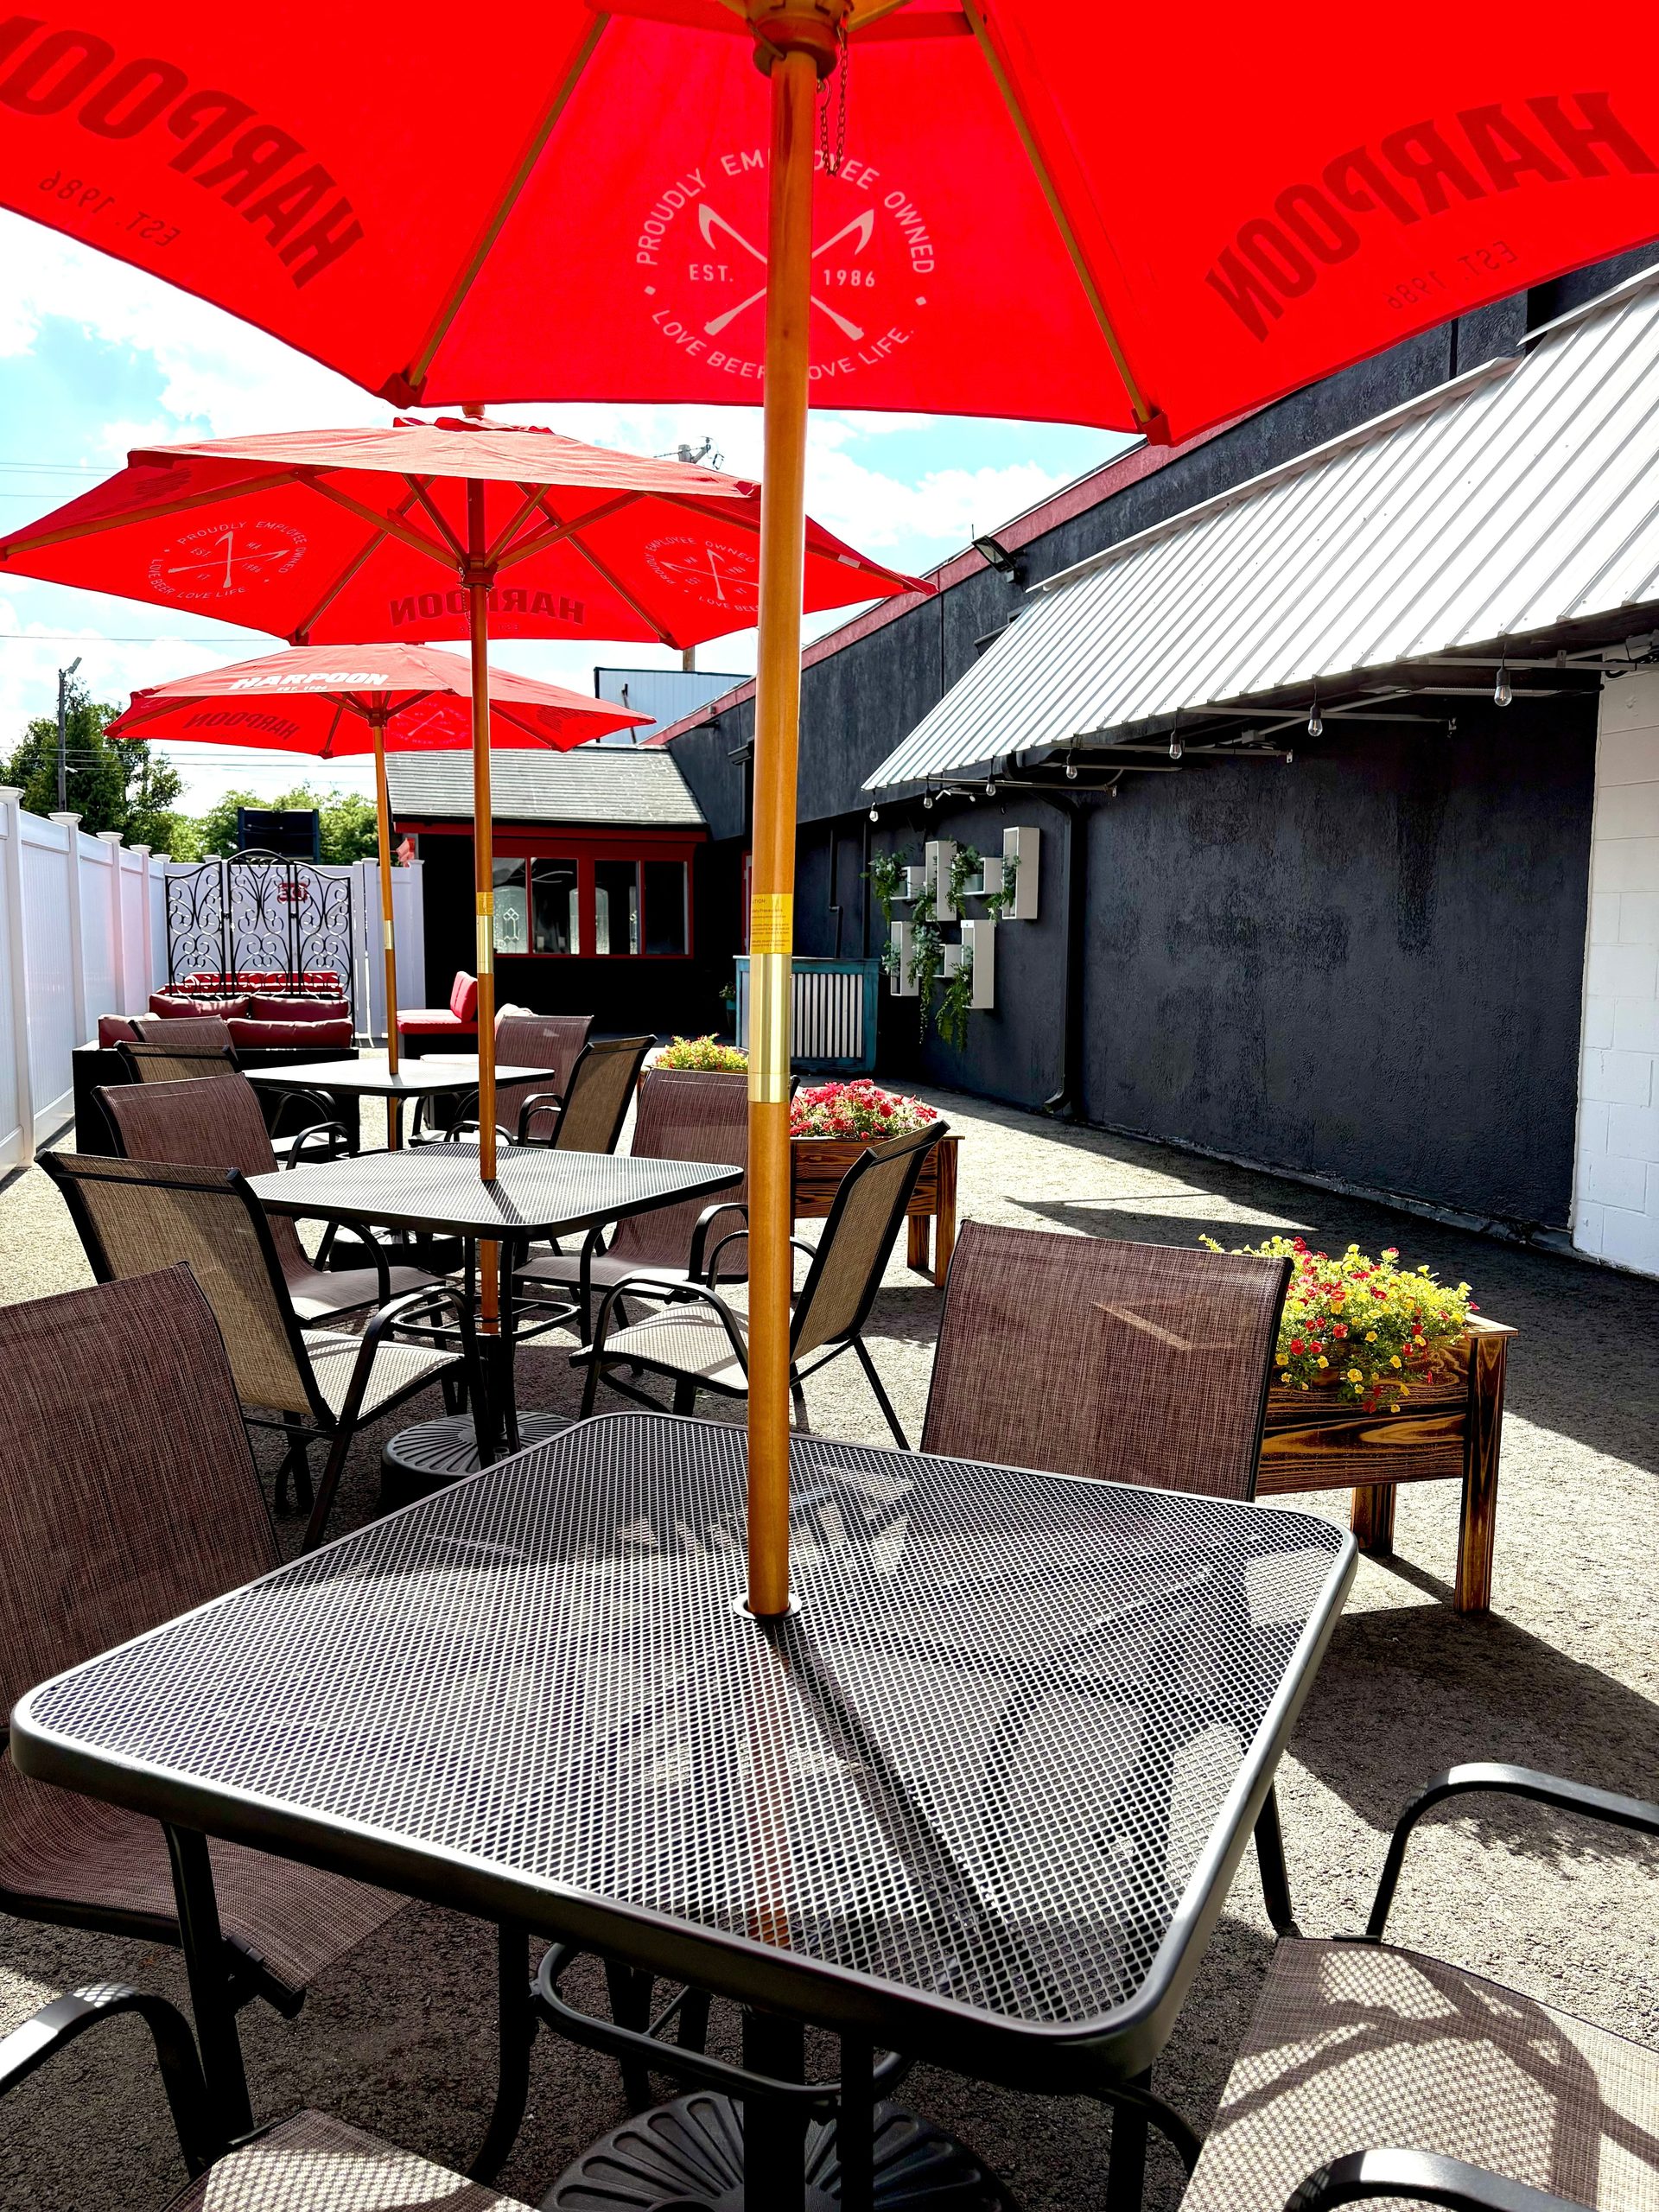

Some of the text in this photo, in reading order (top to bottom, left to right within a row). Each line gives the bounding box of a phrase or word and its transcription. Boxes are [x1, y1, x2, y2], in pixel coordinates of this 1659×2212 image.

[636, 148, 935, 273] PROUDLY EMOYEE OWNED
[689, 264, 875, 288] EST. 1986
[652, 309, 707, 357] LOVE
[809, 357, 856, 380] OVE
[858, 327, 914, 365] LIFE.
[176, 521, 308, 574] PROUDLY EMPLOYEE OWNED
[705, 540, 755, 563] OWNED
[148, 559, 163, 579] LOVE
[699, 596, 730, 609] LOVE
[228, 672, 389, 690] HARPOON
